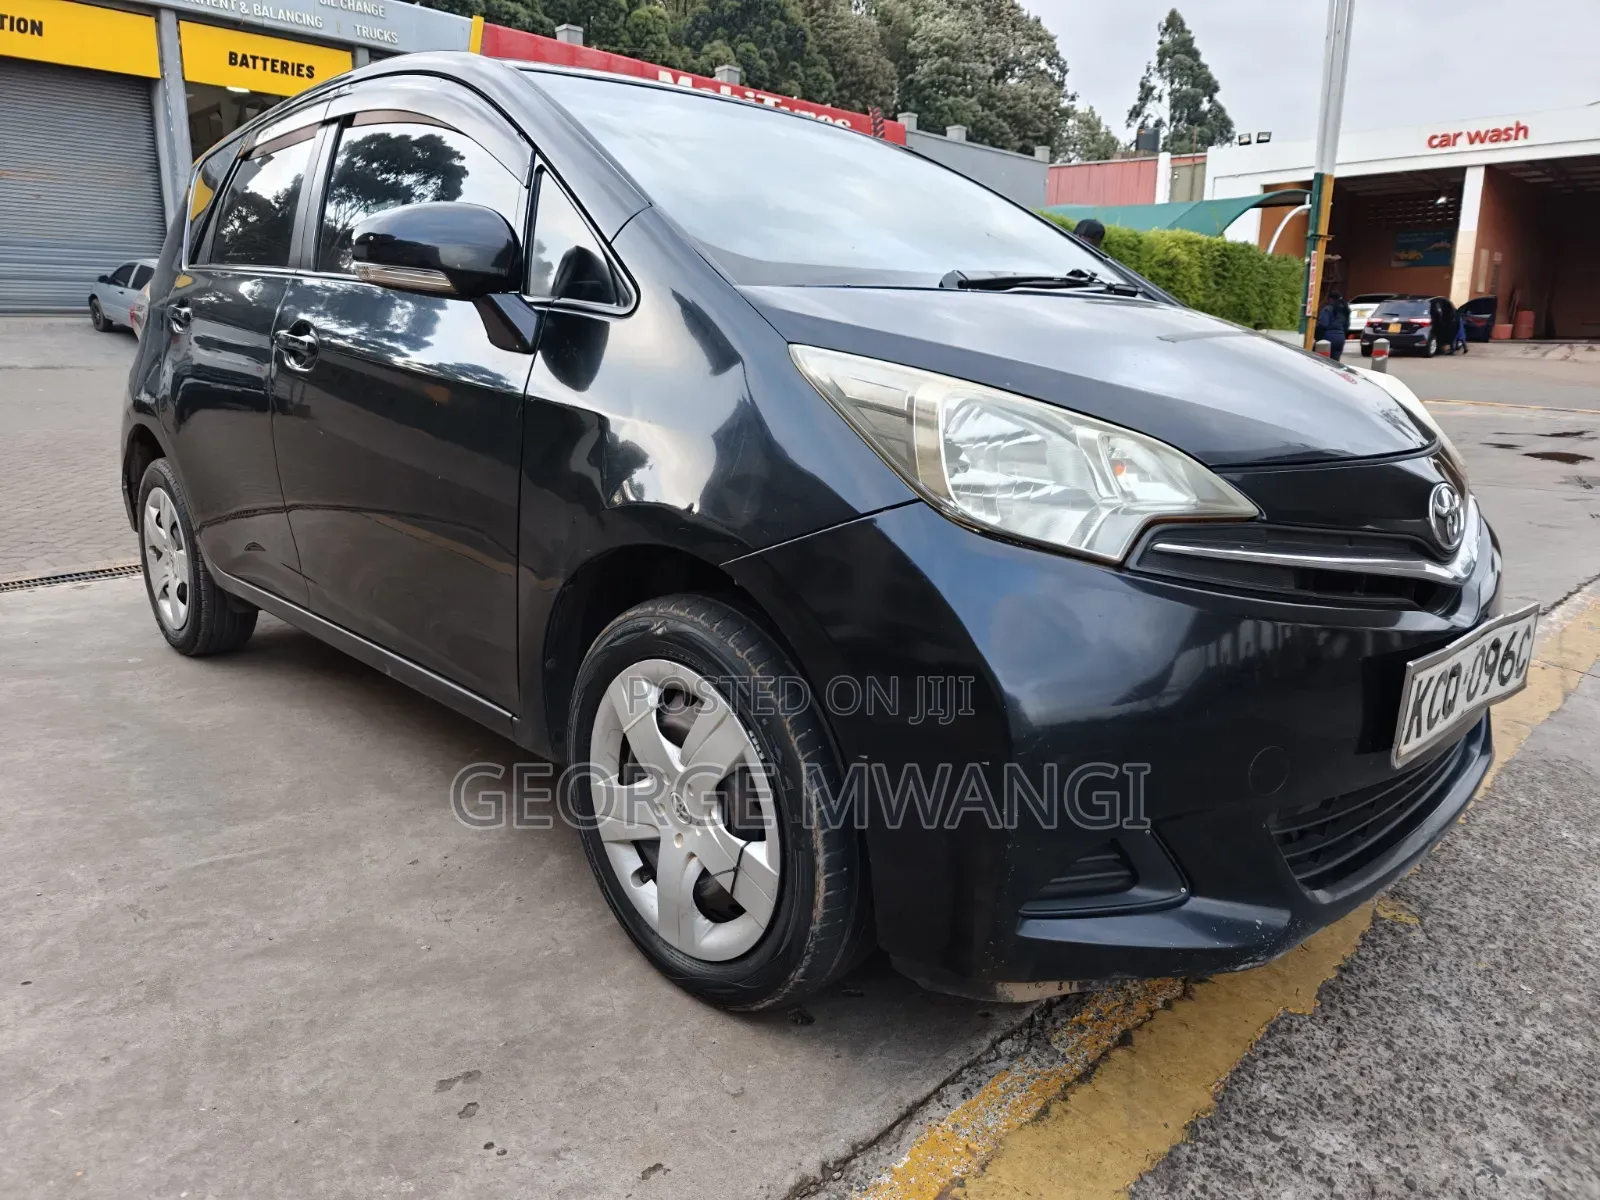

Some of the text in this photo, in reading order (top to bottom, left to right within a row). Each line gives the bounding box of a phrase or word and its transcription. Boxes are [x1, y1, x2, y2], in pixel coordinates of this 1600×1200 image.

[239, 1, 250, 15] &
[253, 3, 323, 28] BALANCING
[354, 24, 398, 44] TRUCKS
[340, 0, 386, 18] CHANGE
[0, 13, 43, 37] TION
[228, 51, 315, 79] BATTERIES
[1427, 120, 1529, 149] car wash
